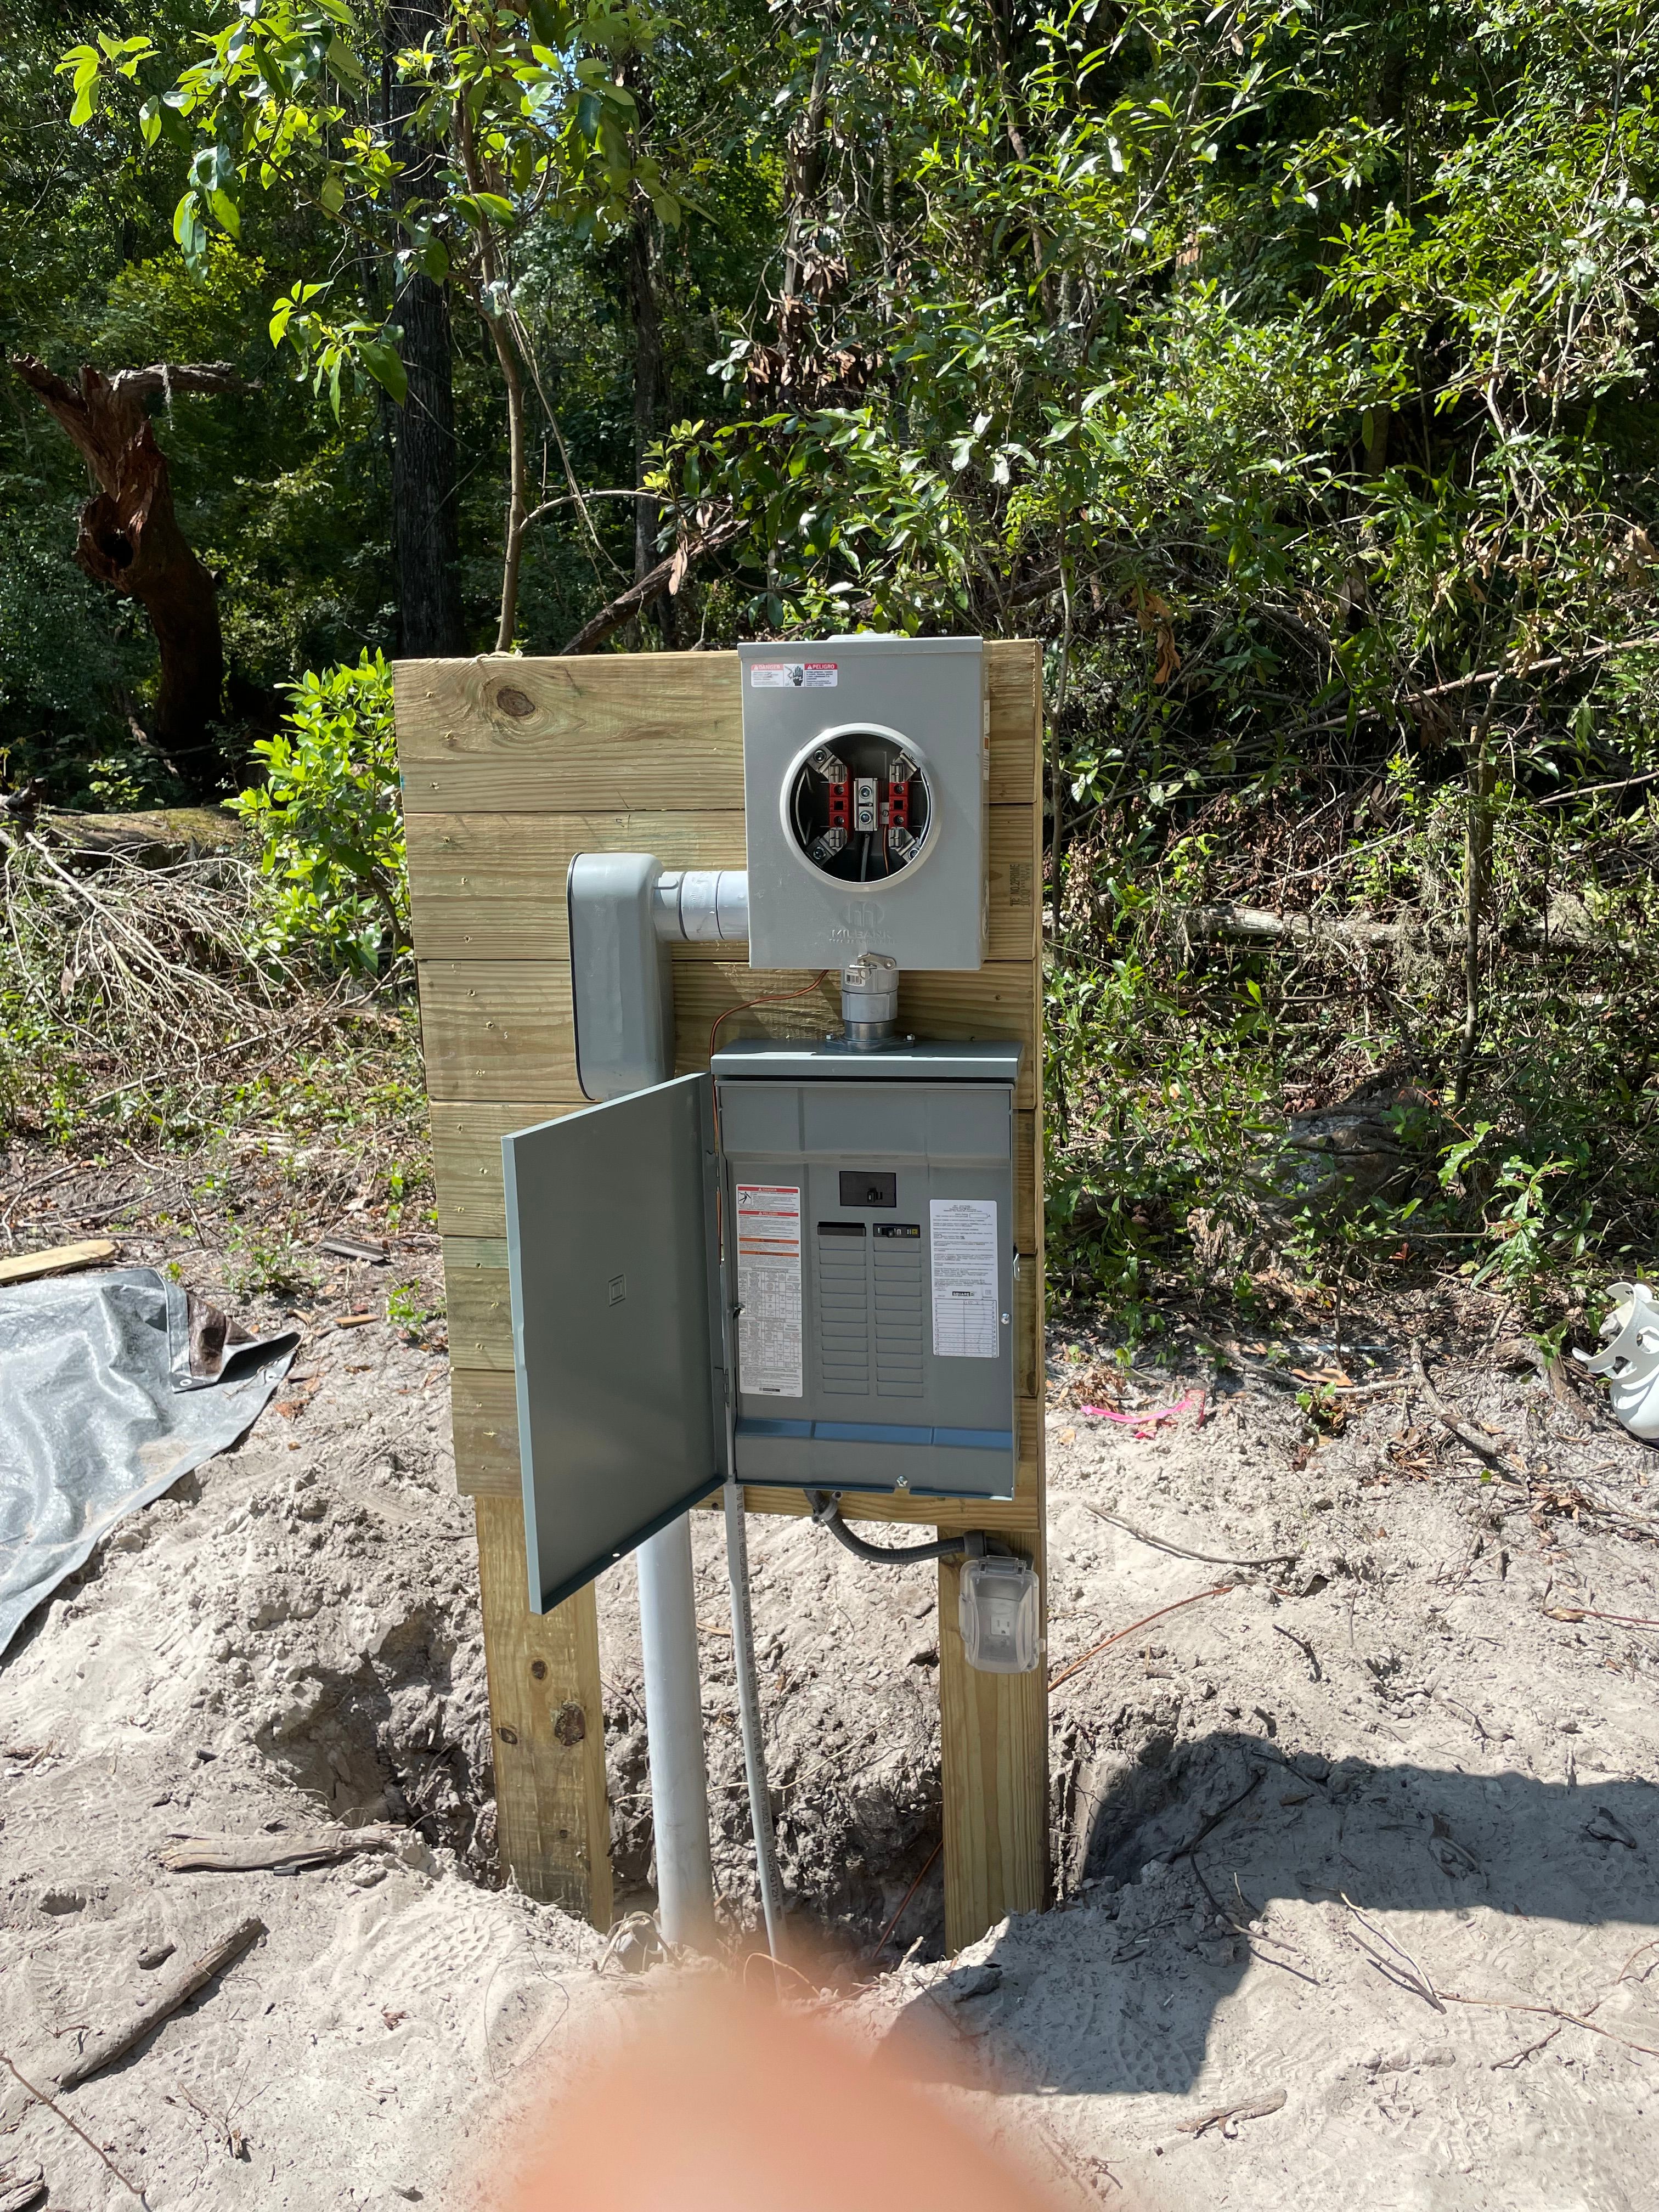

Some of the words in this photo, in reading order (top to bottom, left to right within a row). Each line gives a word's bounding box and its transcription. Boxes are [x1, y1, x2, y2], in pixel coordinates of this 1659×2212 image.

[744, 1640, 754, 1669] SUNLIGHT
[747, 1671, 757, 1703] RESISTANT
[755, 1752, 763, 1768] NEMA
